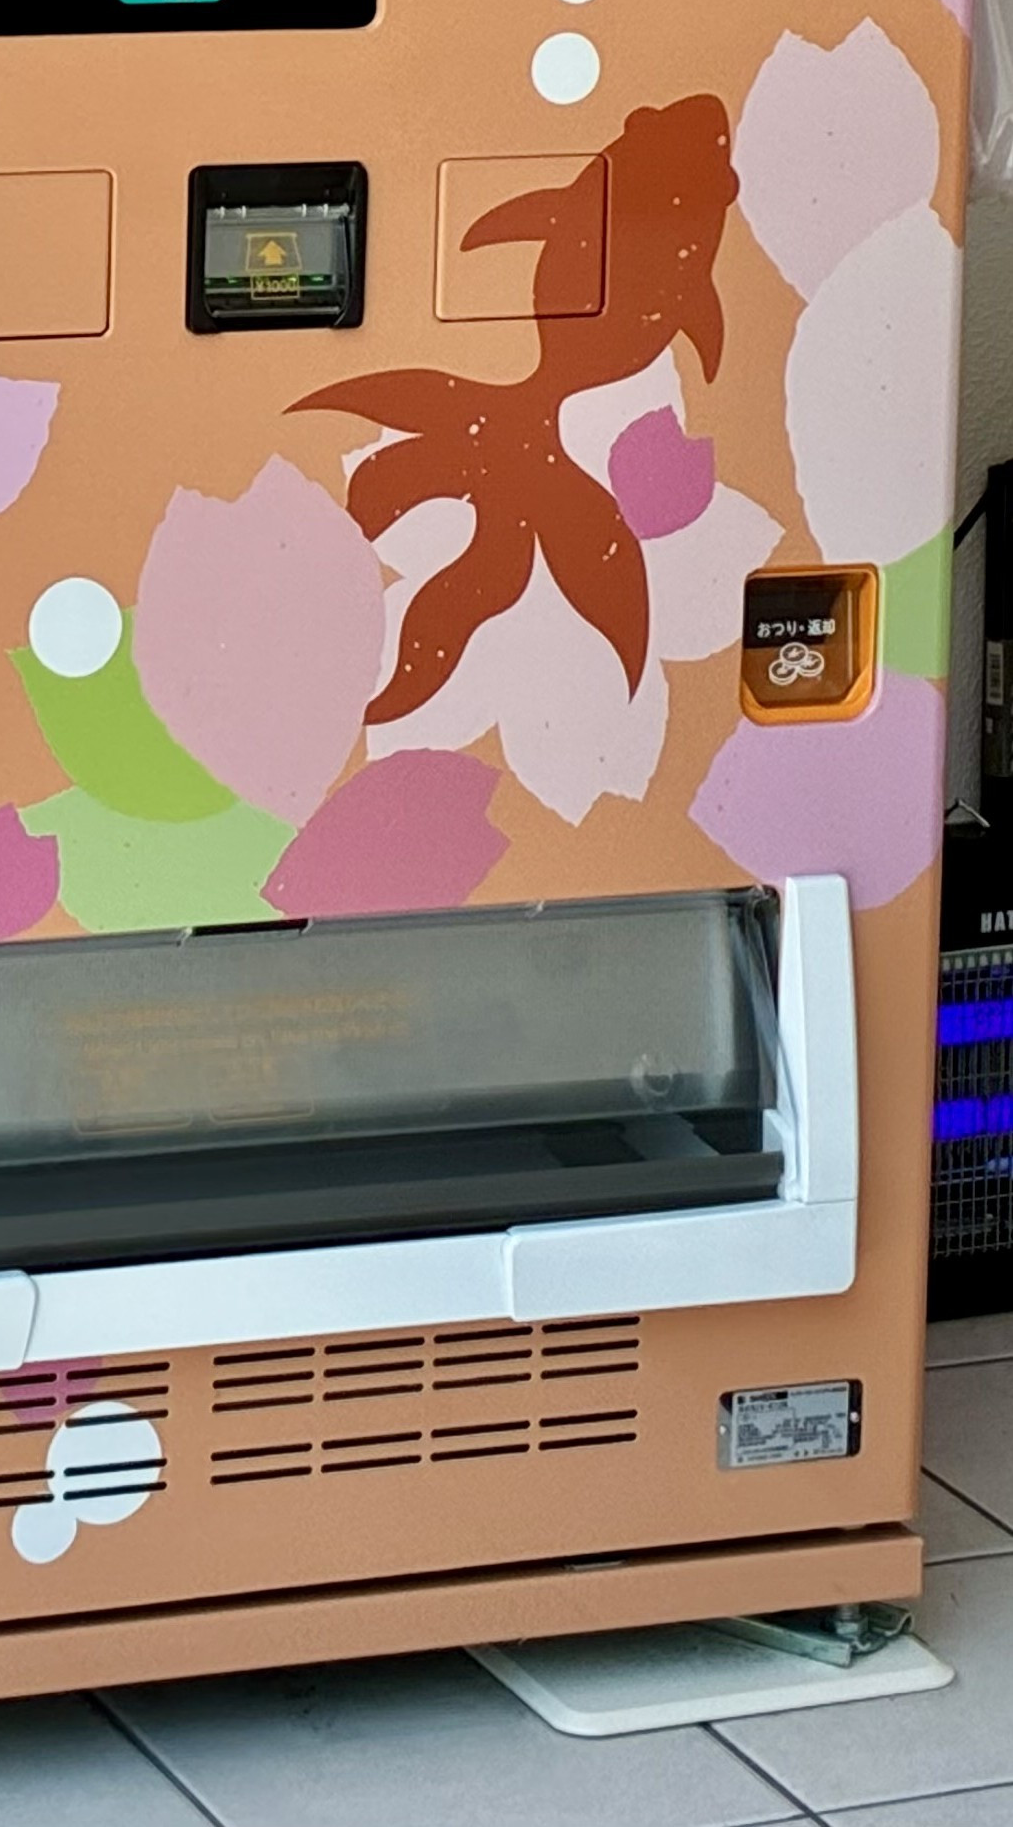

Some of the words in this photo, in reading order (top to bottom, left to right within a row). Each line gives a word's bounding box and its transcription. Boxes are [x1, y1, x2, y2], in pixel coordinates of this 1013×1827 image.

[757, 618, 836, 639] おつり・返却
